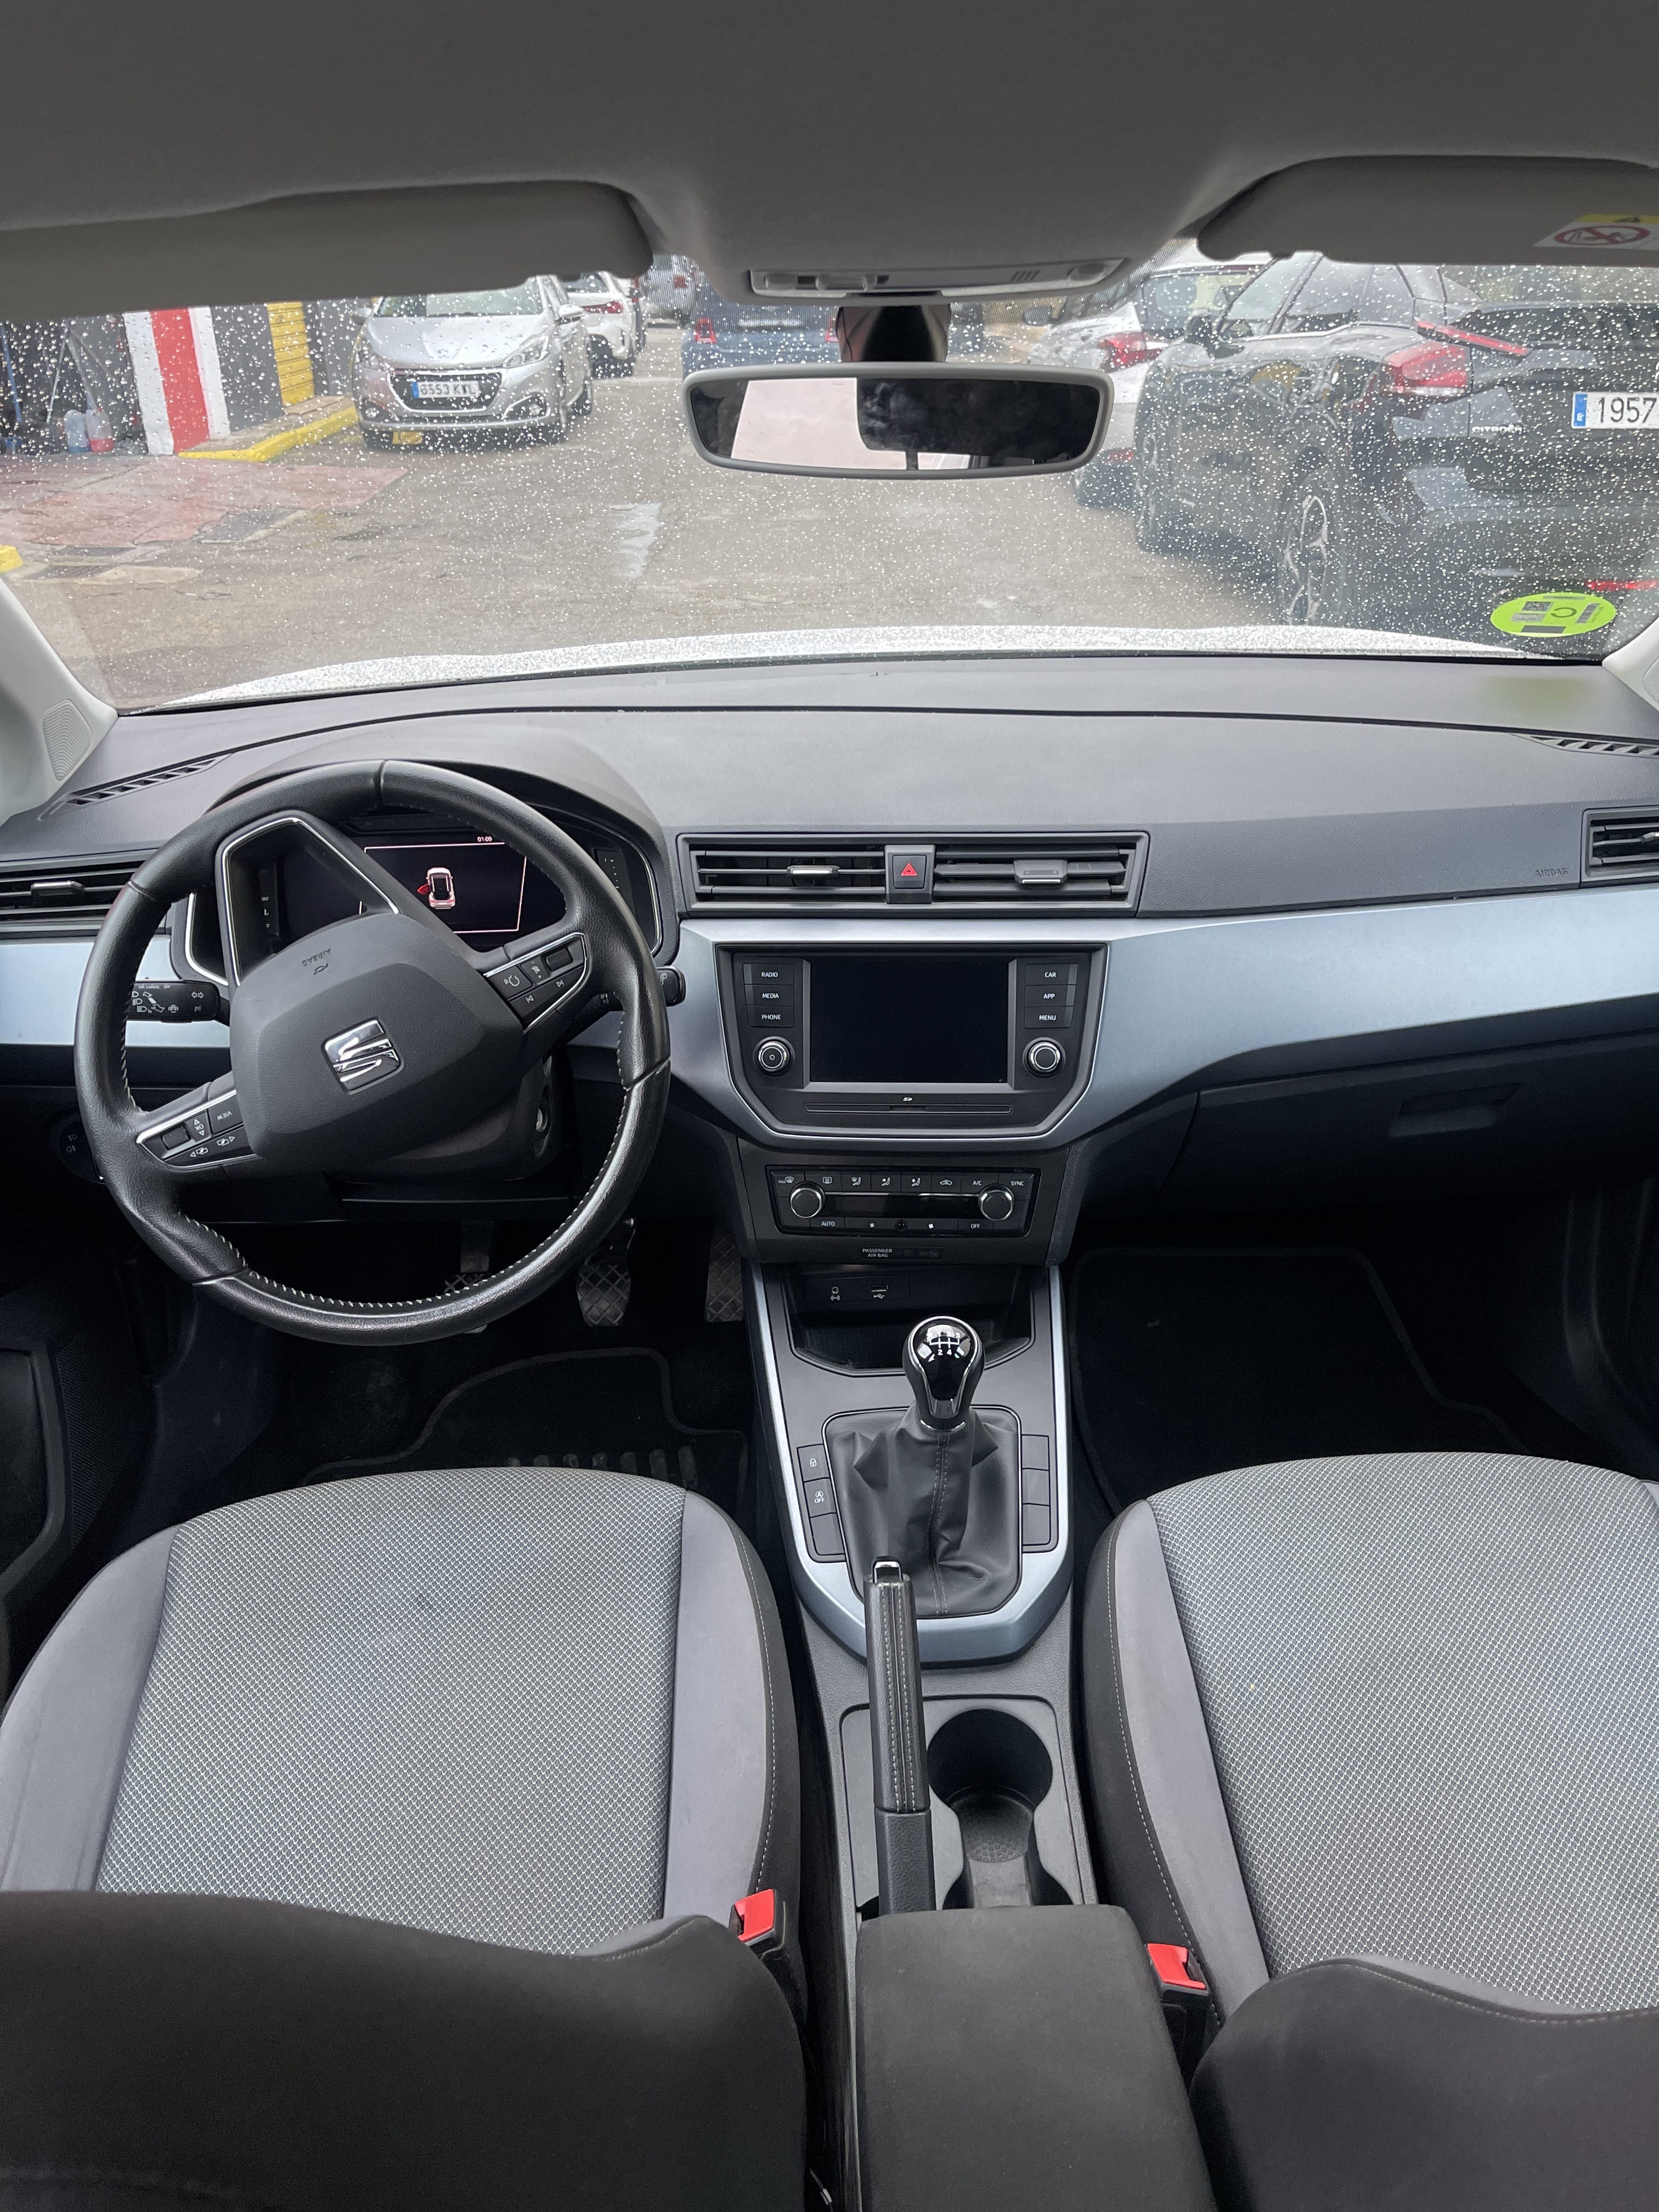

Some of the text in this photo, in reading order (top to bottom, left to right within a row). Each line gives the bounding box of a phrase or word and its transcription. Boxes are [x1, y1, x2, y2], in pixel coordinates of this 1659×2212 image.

[1598, 397, 1657, 424] 1957
[1536, 867, 1568, 878] AIRBAG
[302, 948, 330, 967] AIRBAG
[217, 1110, 233, 1121] VIEW
